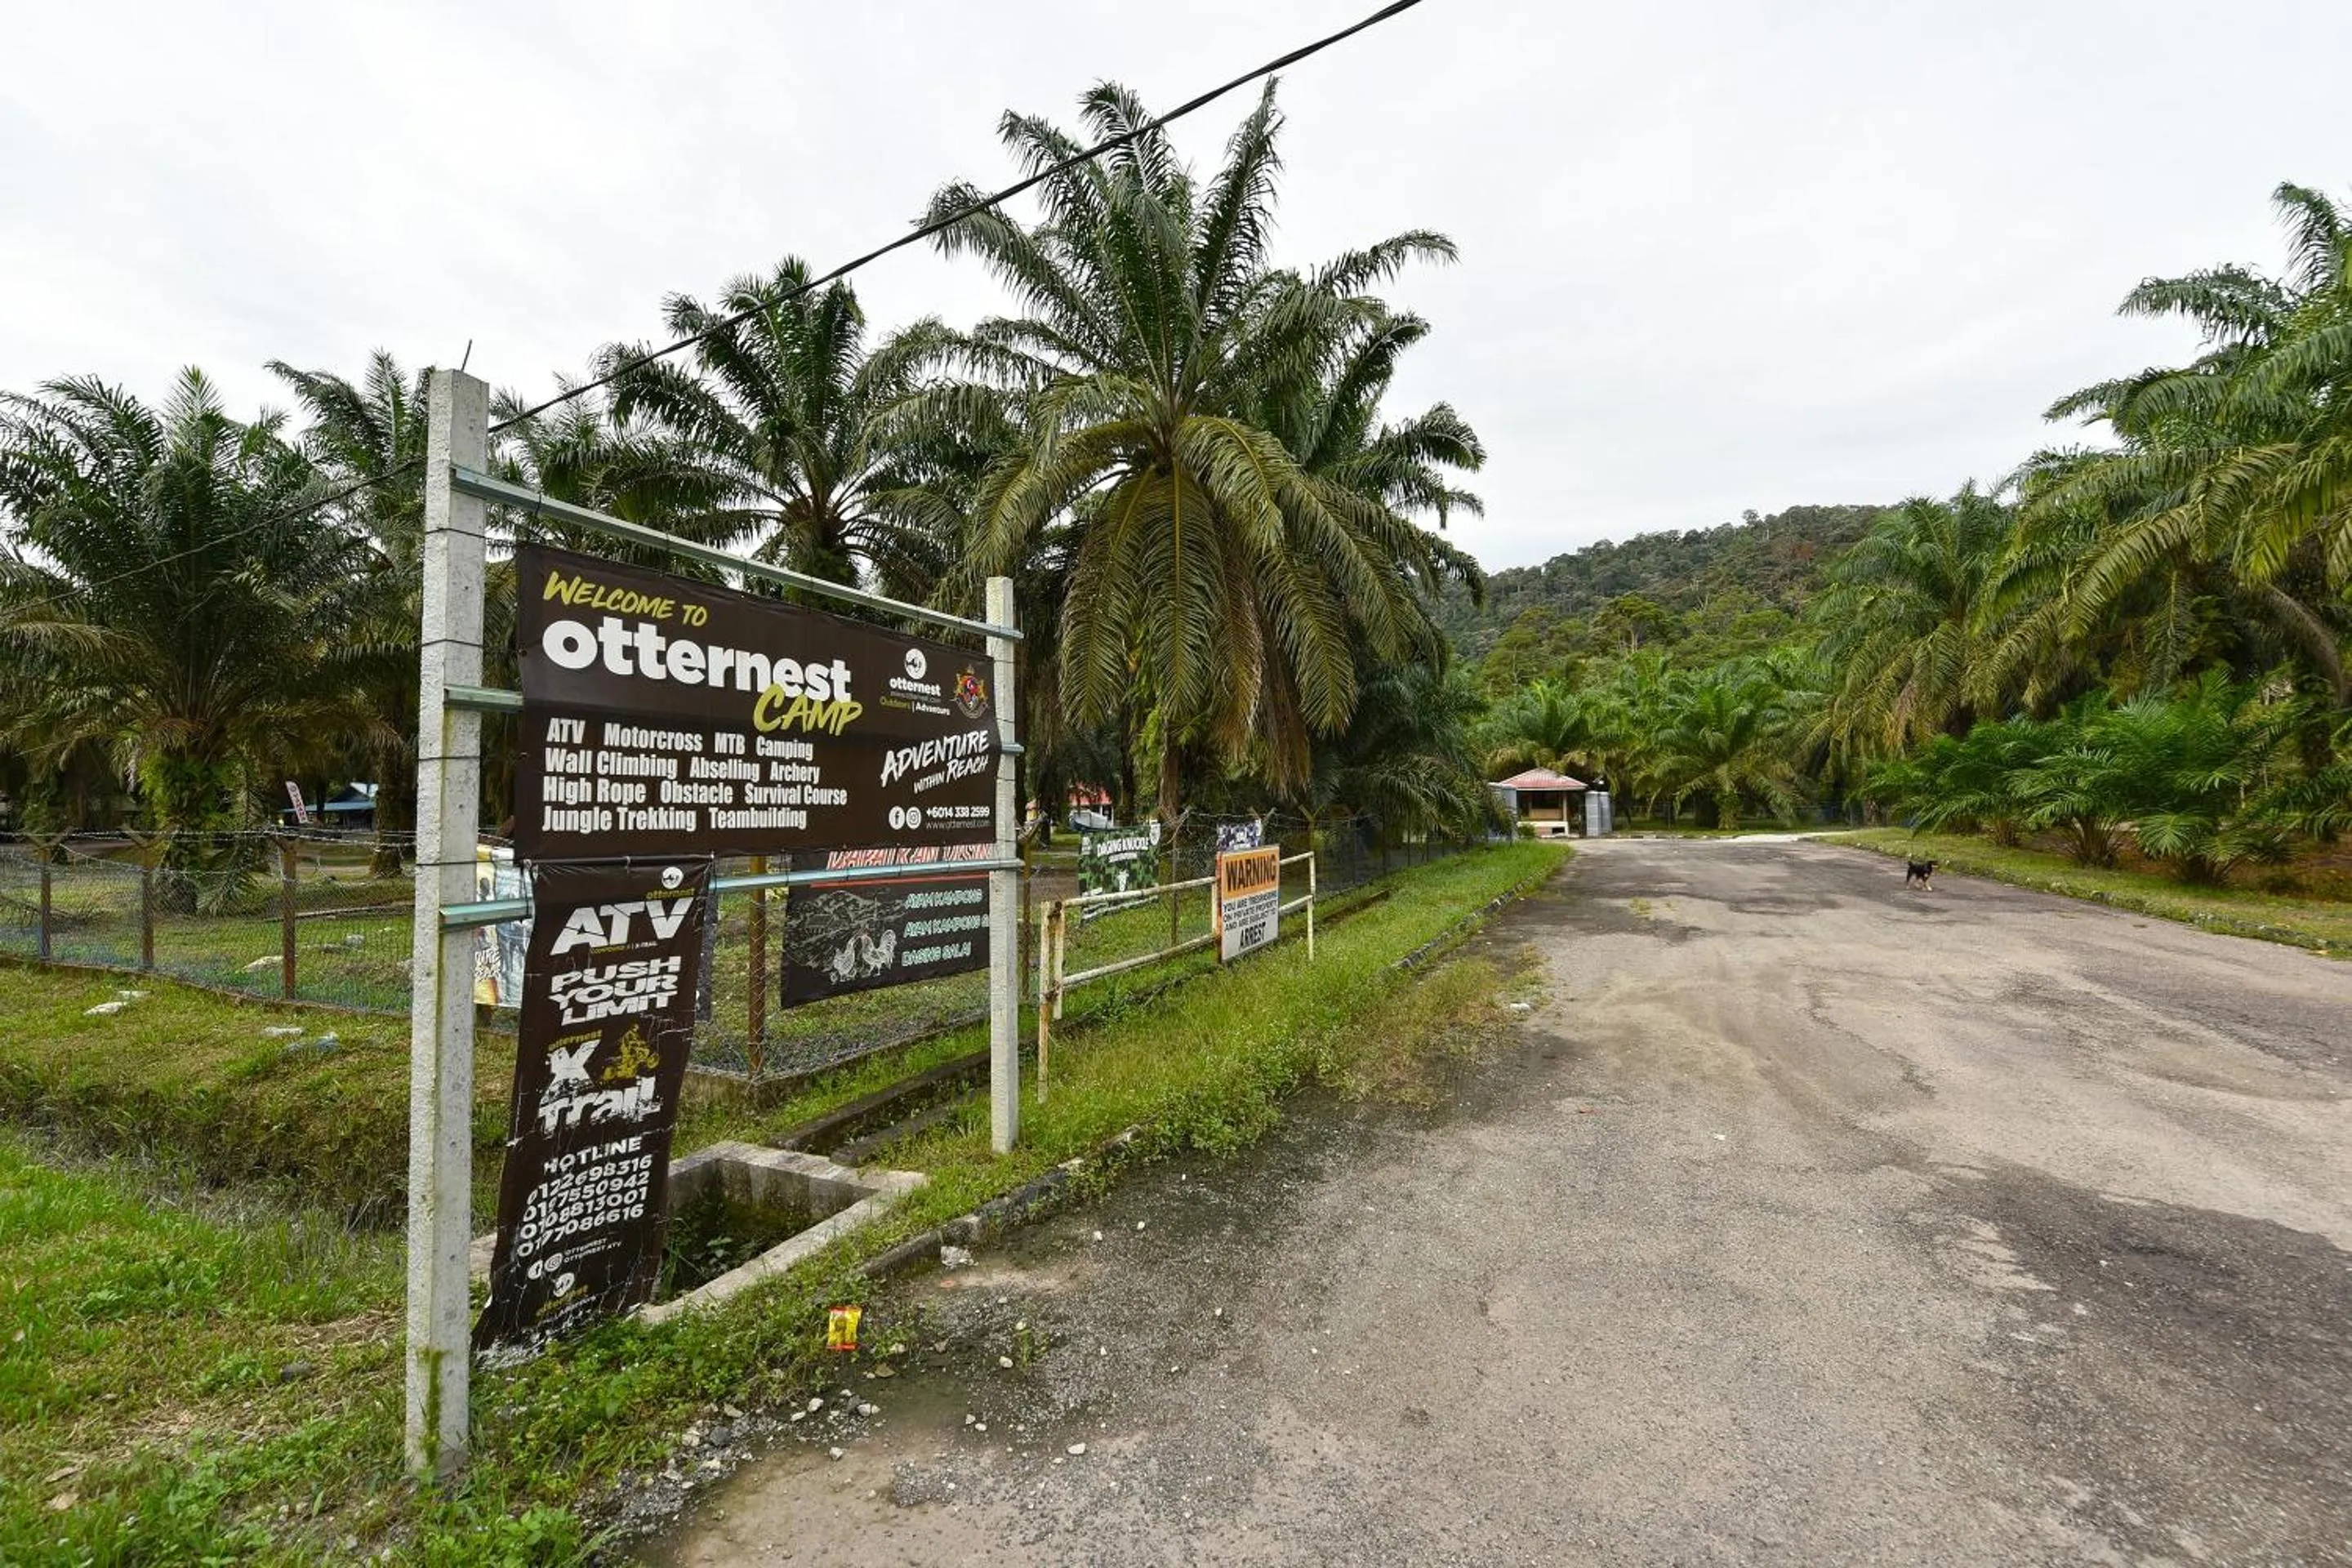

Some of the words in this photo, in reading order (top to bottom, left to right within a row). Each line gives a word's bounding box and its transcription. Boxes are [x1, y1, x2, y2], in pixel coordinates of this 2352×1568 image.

[542, 571, 675, 620] WELCOME
[682, 604, 708, 627] TO
[542, 616, 853, 703] otternest
[889, 677, 942, 697] otternest
[753, 684, 863, 736] CAMP
[546, 718, 586, 744] ATV
[604, 722, 703, 752] Motorcross
[715, 732, 746, 755] MTB
[756, 735, 813, 761] Camping
[880, 729, 990, 787] ADVENTURE
[545, 747, 592, 773] Wall
[597, 751, 678, 779] Climbing
[689, 756, 760, 782] Abselling
[770, 761, 820, 784] Archery
[947, 755, 989, 783] REACH
[543, 776, 592, 805] High
[597, 778, 647, 805] Rope
[660, 780, 733, 804] Obstacle
[744, 782, 802, 804] Survival
[804, 784, 848, 805] Course
[542, 805, 612, 834] Jungle
[617, 806, 697, 832] Trekking
[709, 807, 807, 830] Teambuilding
[1226, 854, 1276, 892] WARNING
[550, 897, 694, 956] ATV
[548, 974, 679, 1009] YOUR
[551, 956, 682, 992] PUSH
[561, 991, 679, 1027] LIMIT
[541, 1039, 601, 1107] X
[544, 1136, 643, 1174] HOTLINE
[527, 1154, 653, 1205] 0122698316
[517, 1204, 644, 1257] 0177086616
[520, 1187, 648, 1239] 0108813001
